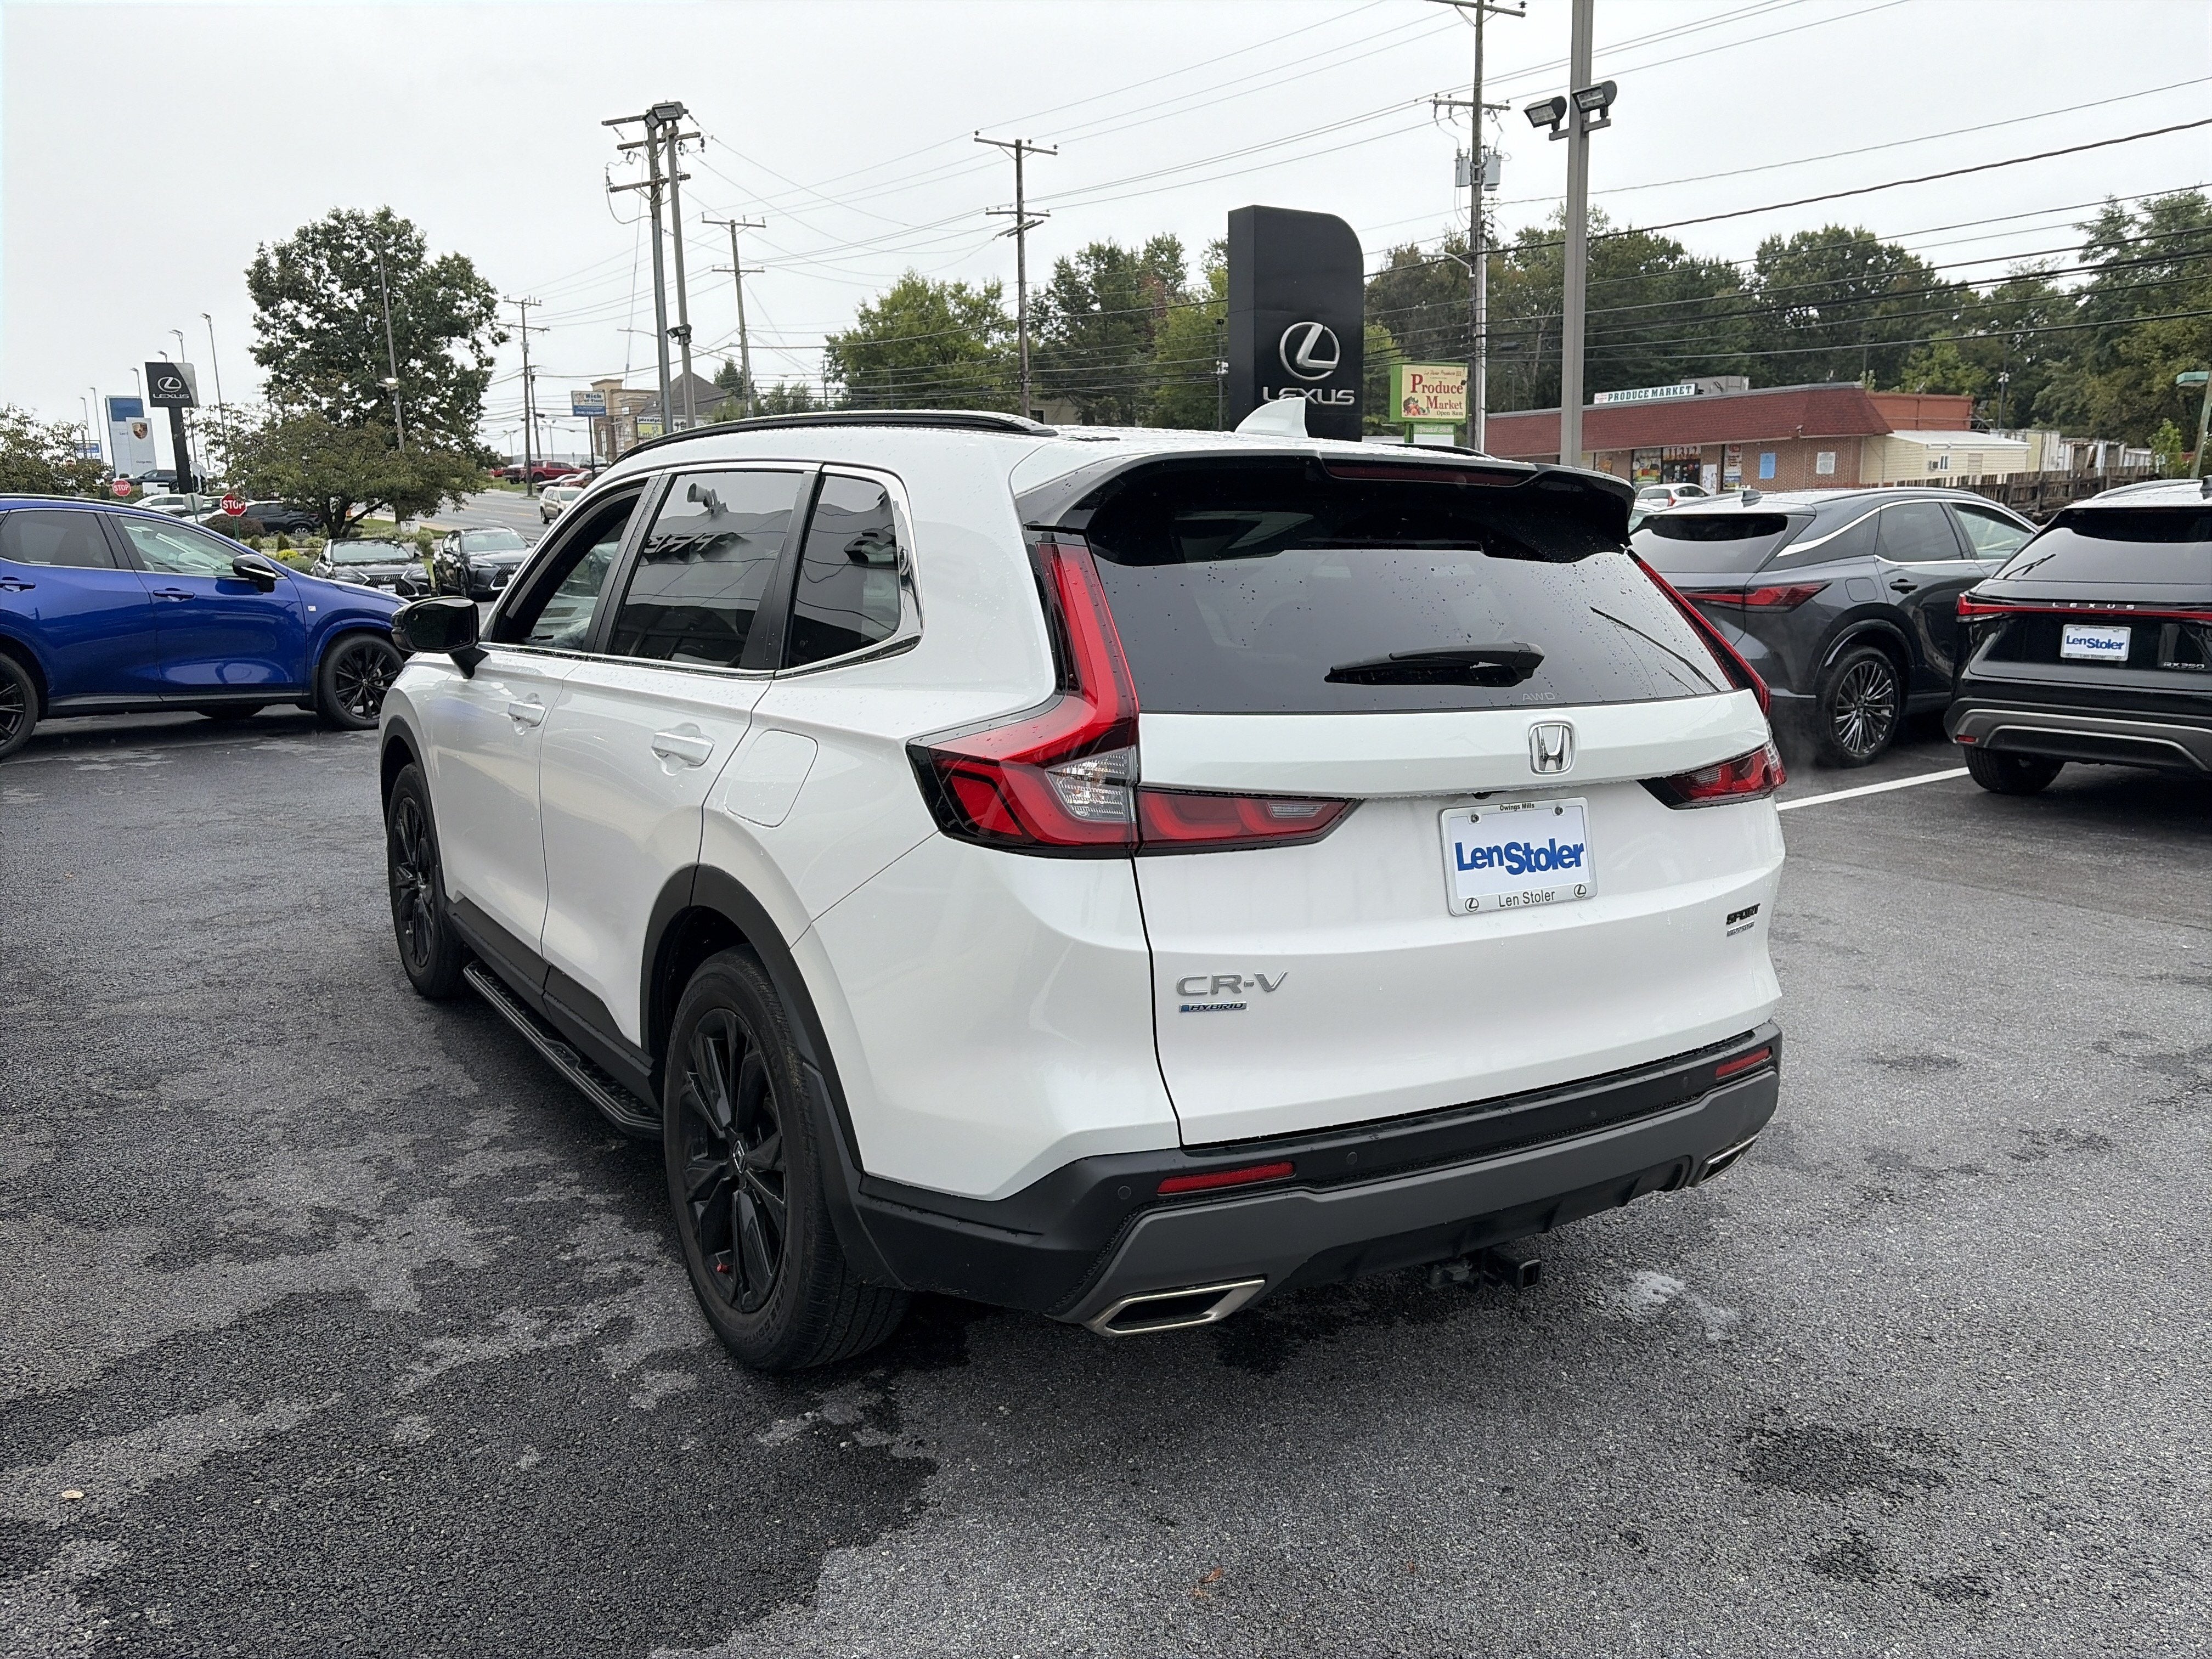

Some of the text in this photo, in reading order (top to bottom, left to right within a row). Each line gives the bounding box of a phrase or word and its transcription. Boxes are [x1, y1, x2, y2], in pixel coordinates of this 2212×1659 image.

[1410, 374, 1464, 394] Produce
[1263, 386, 1355, 405] LEXUS
[1426, 396, 1463, 409] Market
[1607, 390, 1649, 402] PRODUCE
[1651, 386, 1692, 397] MARKET
[223, 499, 244, 510] STOP
[1522, 692, 1555, 702] AWD
[1498, 890, 1555, 908] Len Stoler
[1726, 902, 1760, 925] SPORT
[1176, 970, 1289, 996] CR-V
[1189, 1003, 1244, 1012] HYBRID
